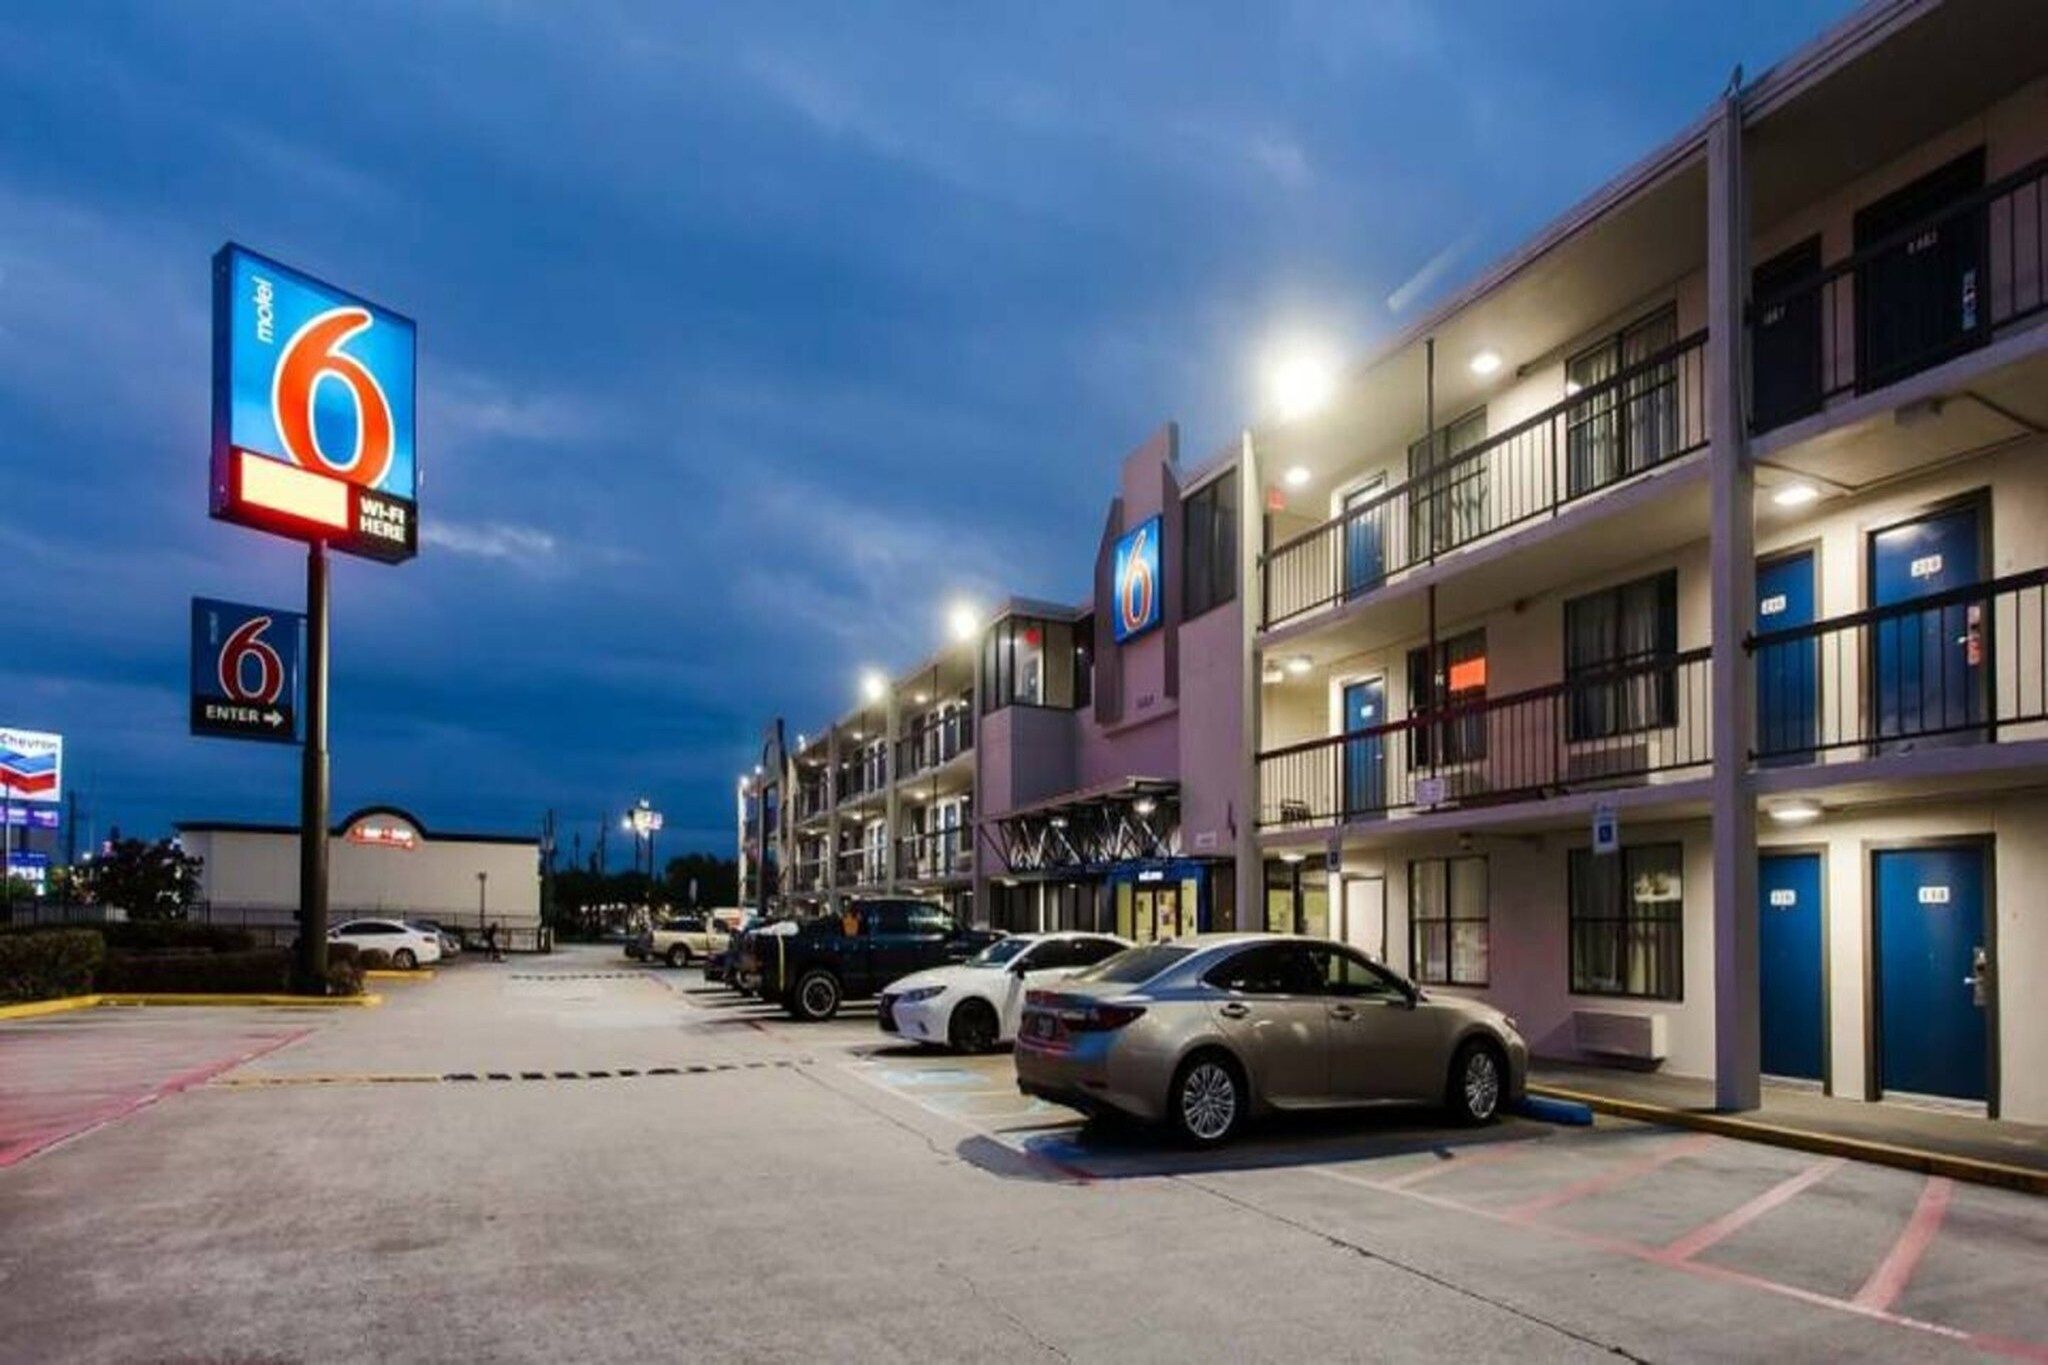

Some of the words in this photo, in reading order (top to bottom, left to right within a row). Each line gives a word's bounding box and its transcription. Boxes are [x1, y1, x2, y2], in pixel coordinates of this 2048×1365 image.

[252, 275, 274, 344] motel
[272, 306, 394, 489] 6
[360, 496, 405, 524] WI-FI
[360, 515, 405, 542] HERE
[1122, 529, 1152, 632] 6
[217, 616, 284, 705] 6
[205, 704, 260, 723] ENTER
[0, 731, 58, 750] Chevron
